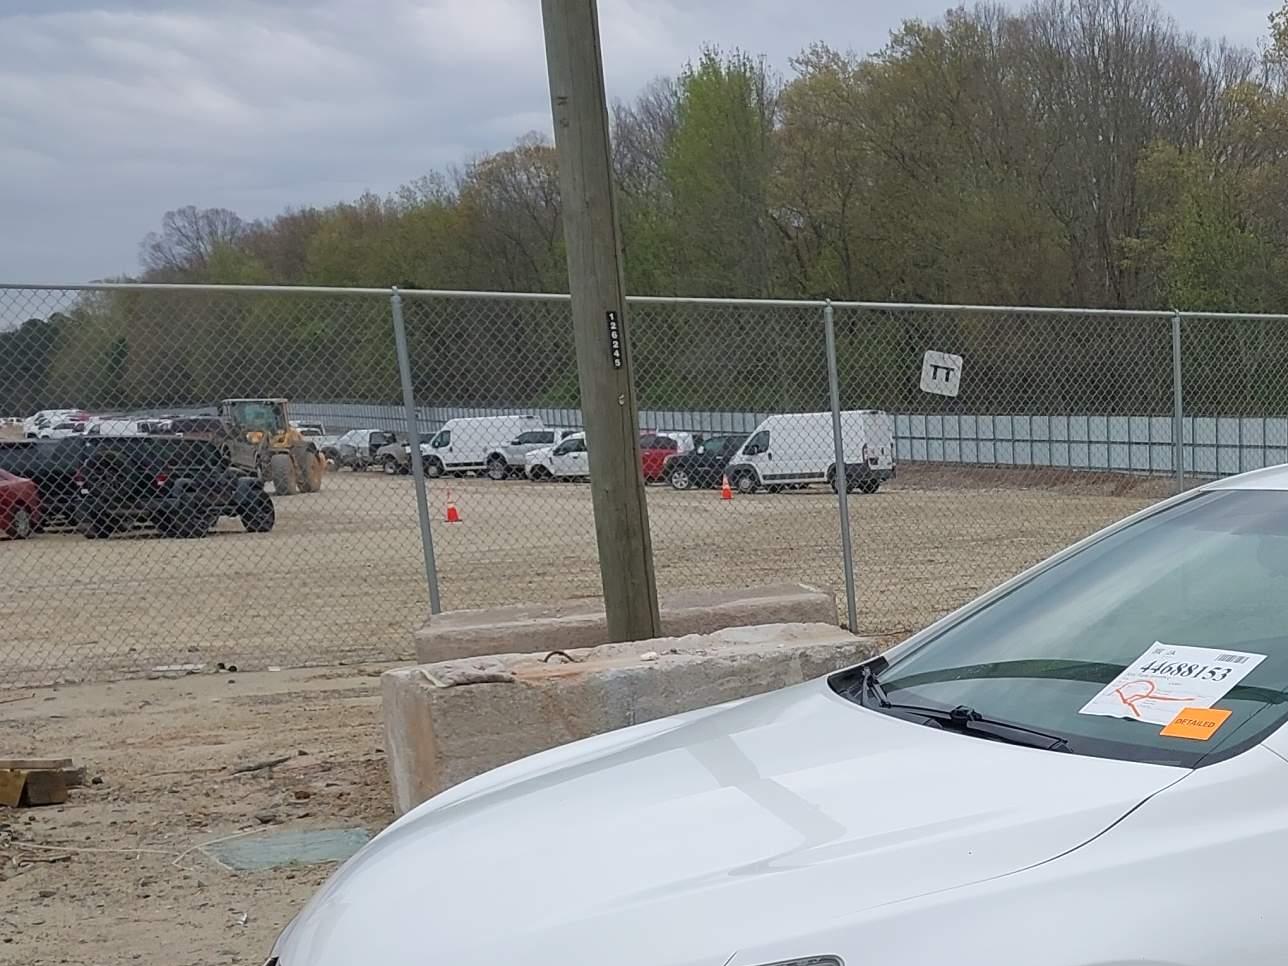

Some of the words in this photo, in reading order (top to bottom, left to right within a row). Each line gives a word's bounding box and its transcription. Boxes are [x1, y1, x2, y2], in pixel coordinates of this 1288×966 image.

[930, 364, 955, 382] TT
[1140, 660, 1232, 682] 44688153
[1176, 718, 1216, 729] DETAILED
